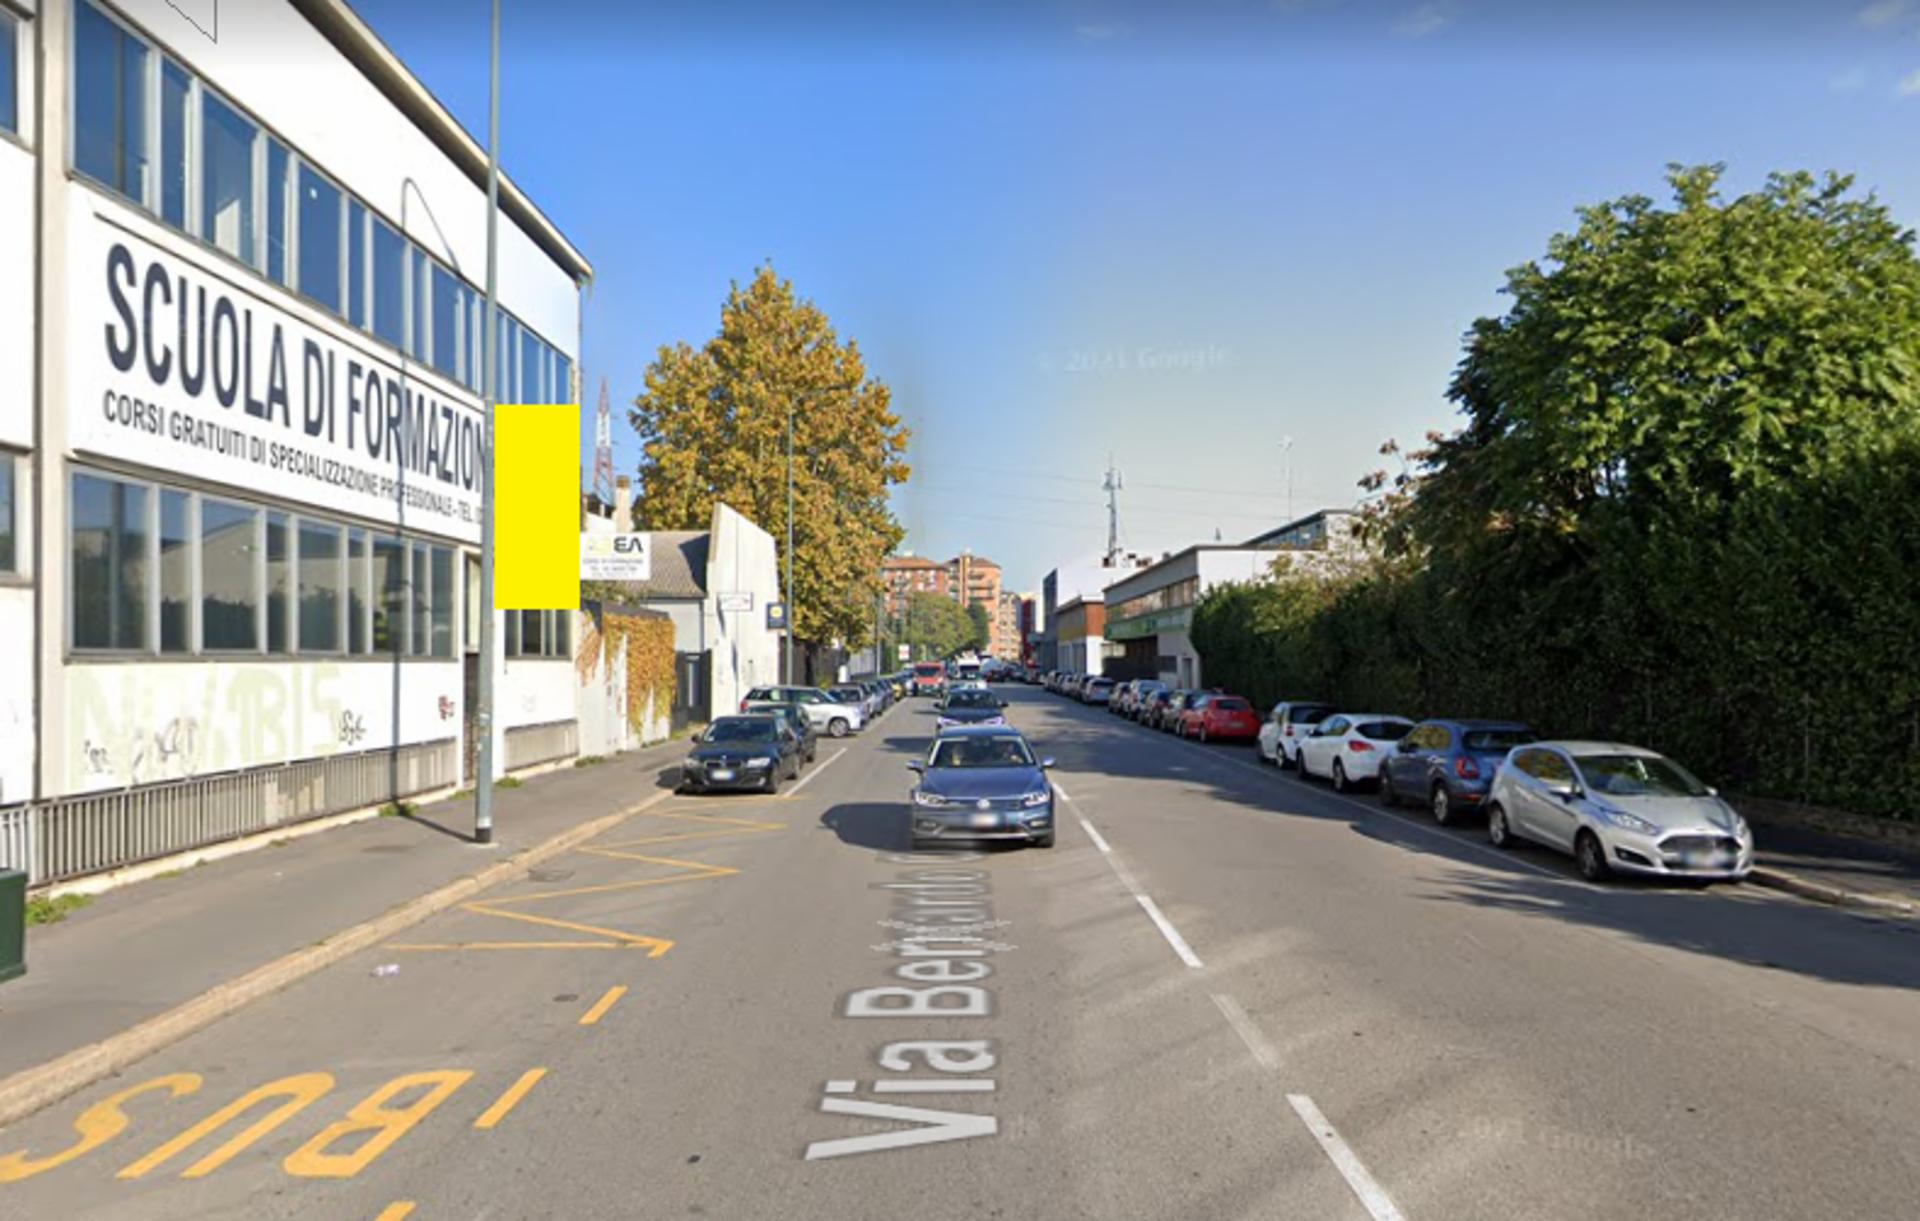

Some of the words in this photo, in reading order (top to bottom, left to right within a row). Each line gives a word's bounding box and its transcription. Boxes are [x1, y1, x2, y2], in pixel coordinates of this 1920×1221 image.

[104, 243, 290, 429] SCUOLA
[304, 338, 335, 443] DI
[103, 390, 165, 436] CORSI
[170, 411, 247, 459] GRATUITI
[250, 436, 266, 465] DI
[270, 442, 379, 497] SPECIALIZZAZIONE
[380, 475, 452, 517] PROFESSIONALE
[0, 1068, 475, 1184] BUS
